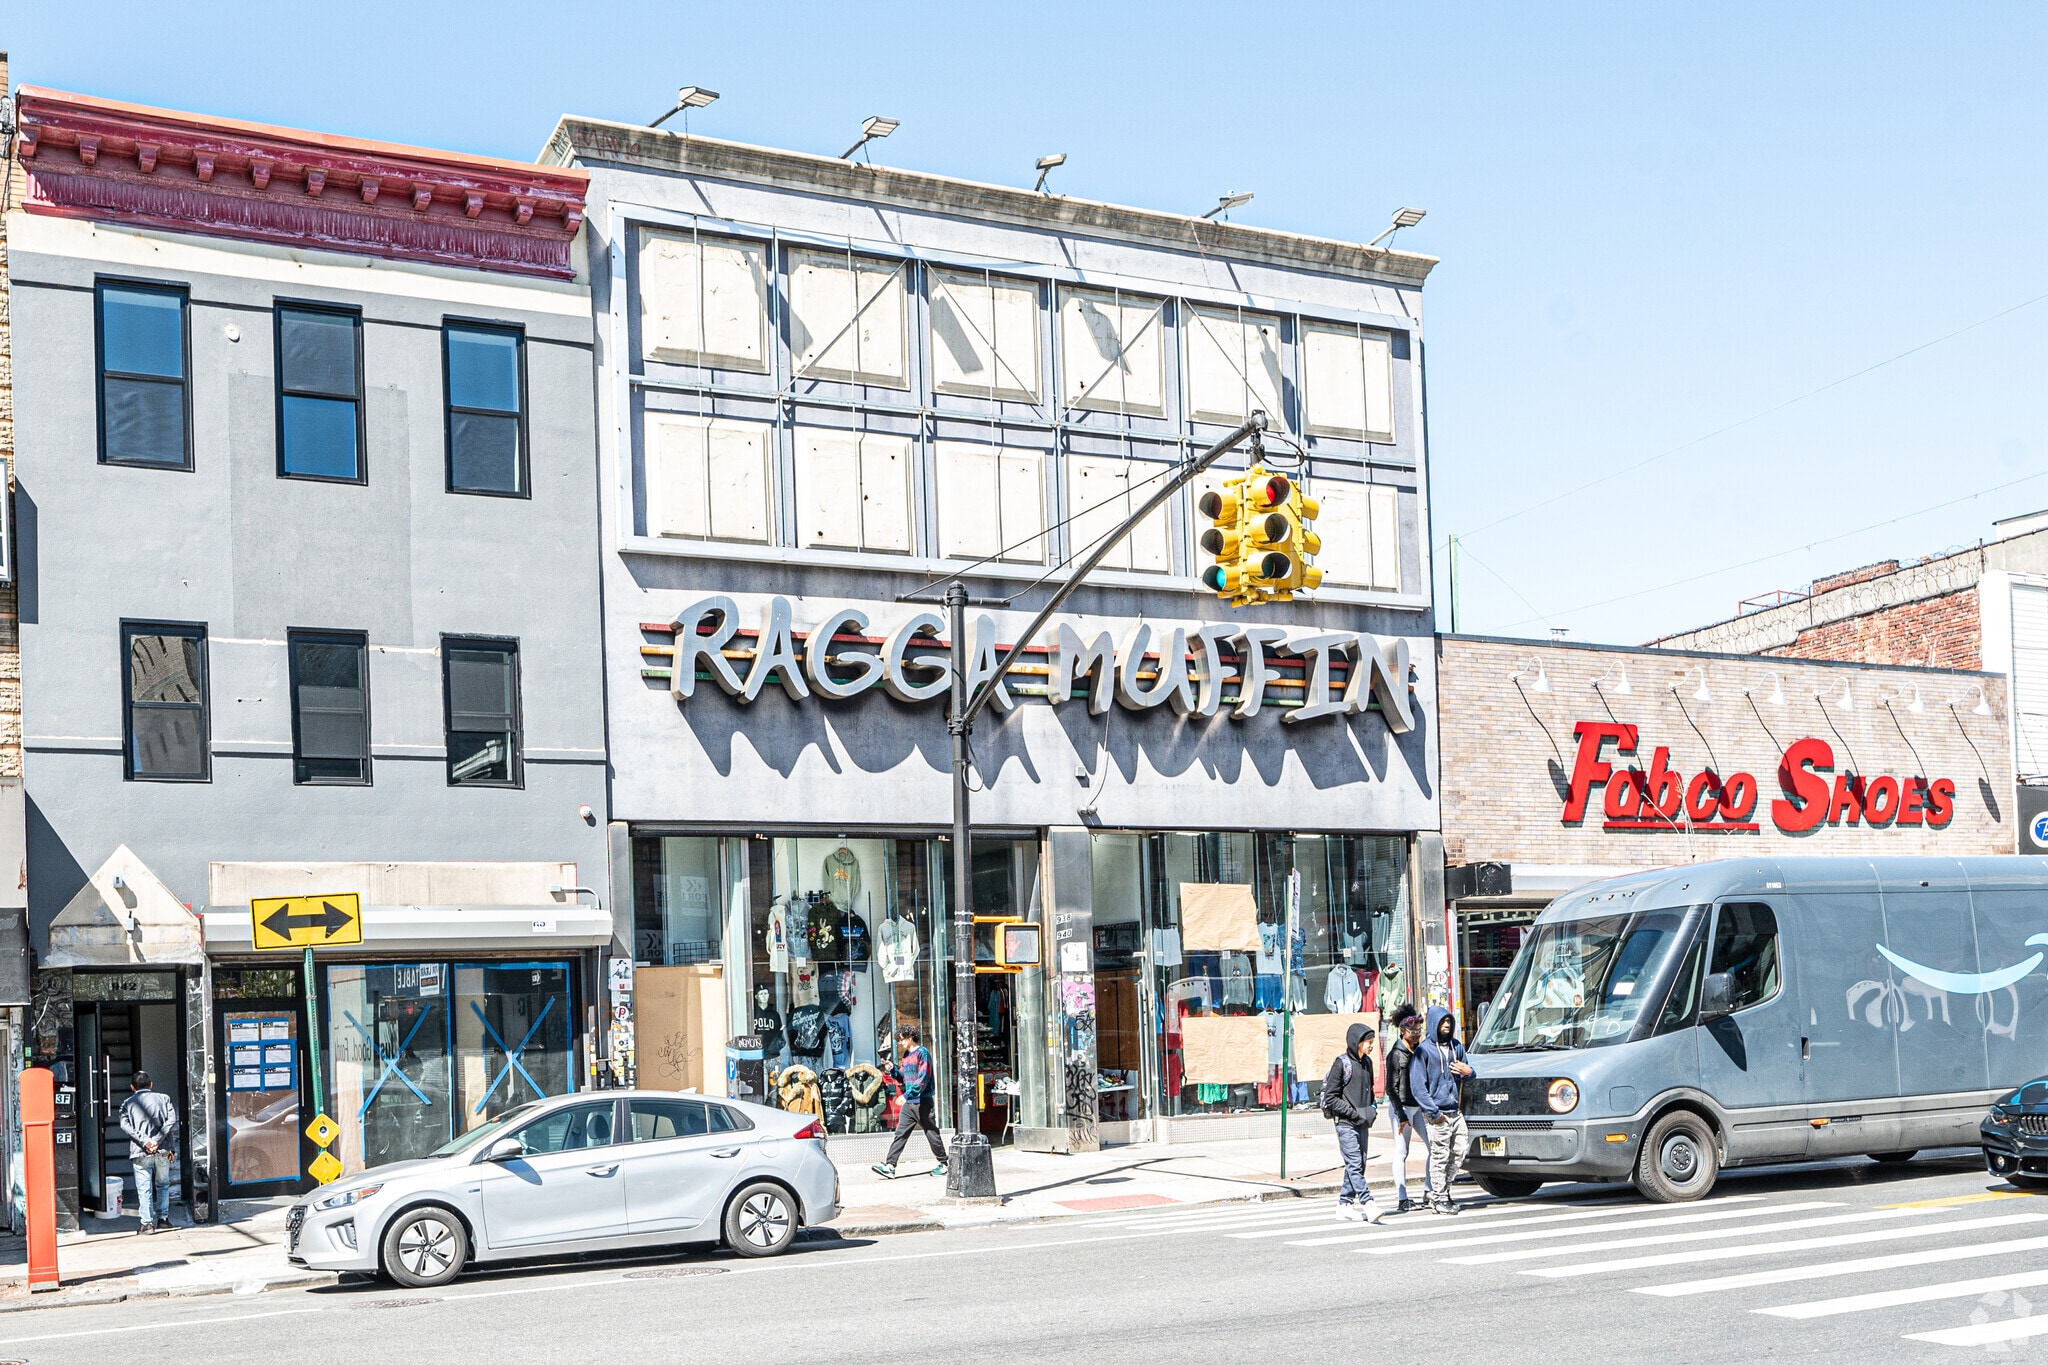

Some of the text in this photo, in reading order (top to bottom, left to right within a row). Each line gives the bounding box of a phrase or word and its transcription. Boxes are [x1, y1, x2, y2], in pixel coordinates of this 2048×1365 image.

[669, 595, 1416, 734] RAGGA MUFFIN
[1771, 737, 1956, 834] SHOES
[1057, 929, 1072, 939] 940
[753, 1017, 775, 1029] POLO
[56, 1094, 70, 1103] 3F
[1486, 1093, 1509, 1102] amazon
[57, 1133, 71, 1143] 2F
